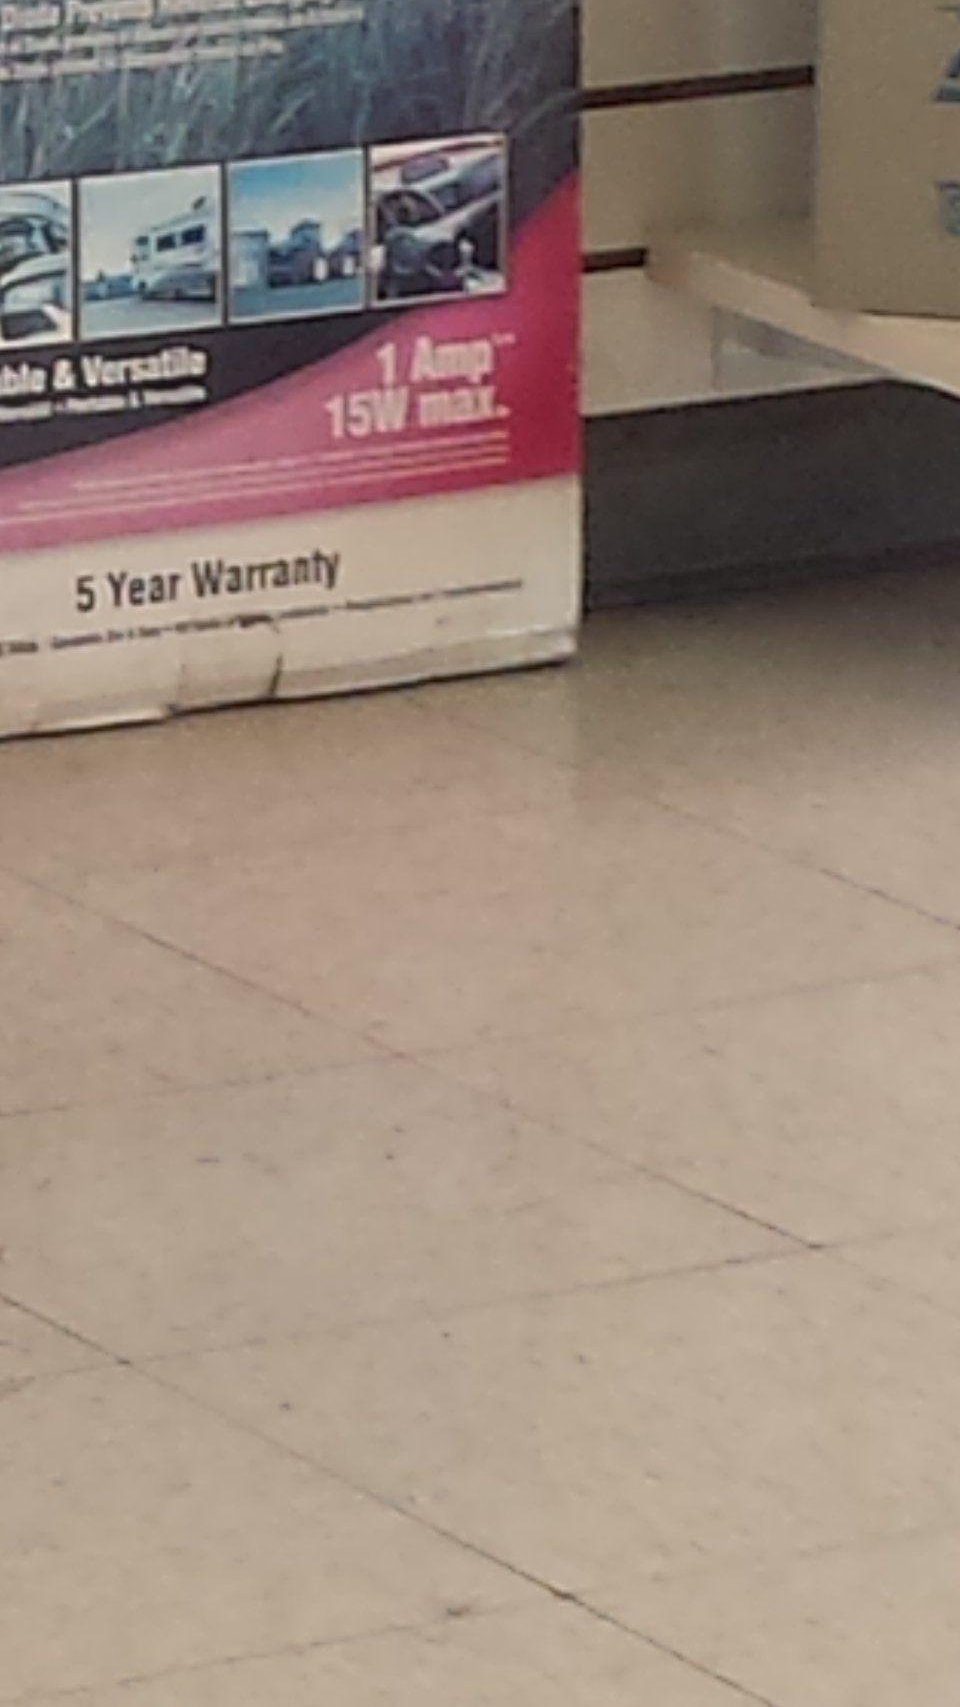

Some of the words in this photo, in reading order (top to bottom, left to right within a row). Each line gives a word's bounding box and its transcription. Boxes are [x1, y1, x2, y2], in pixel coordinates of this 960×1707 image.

[53, 357, 74, 391] &
[80, 346, 207, 387] Versatile
[377, 343, 396, 383] 1
[411, 336, 496, 384] Amp
[325, 386, 408, 438] 15W
[418, 385, 511, 428] max.
[76, 574, 95, 612] 5
[106, 568, 180, 606] Year
[190, 549, 340, 598] Warranty
